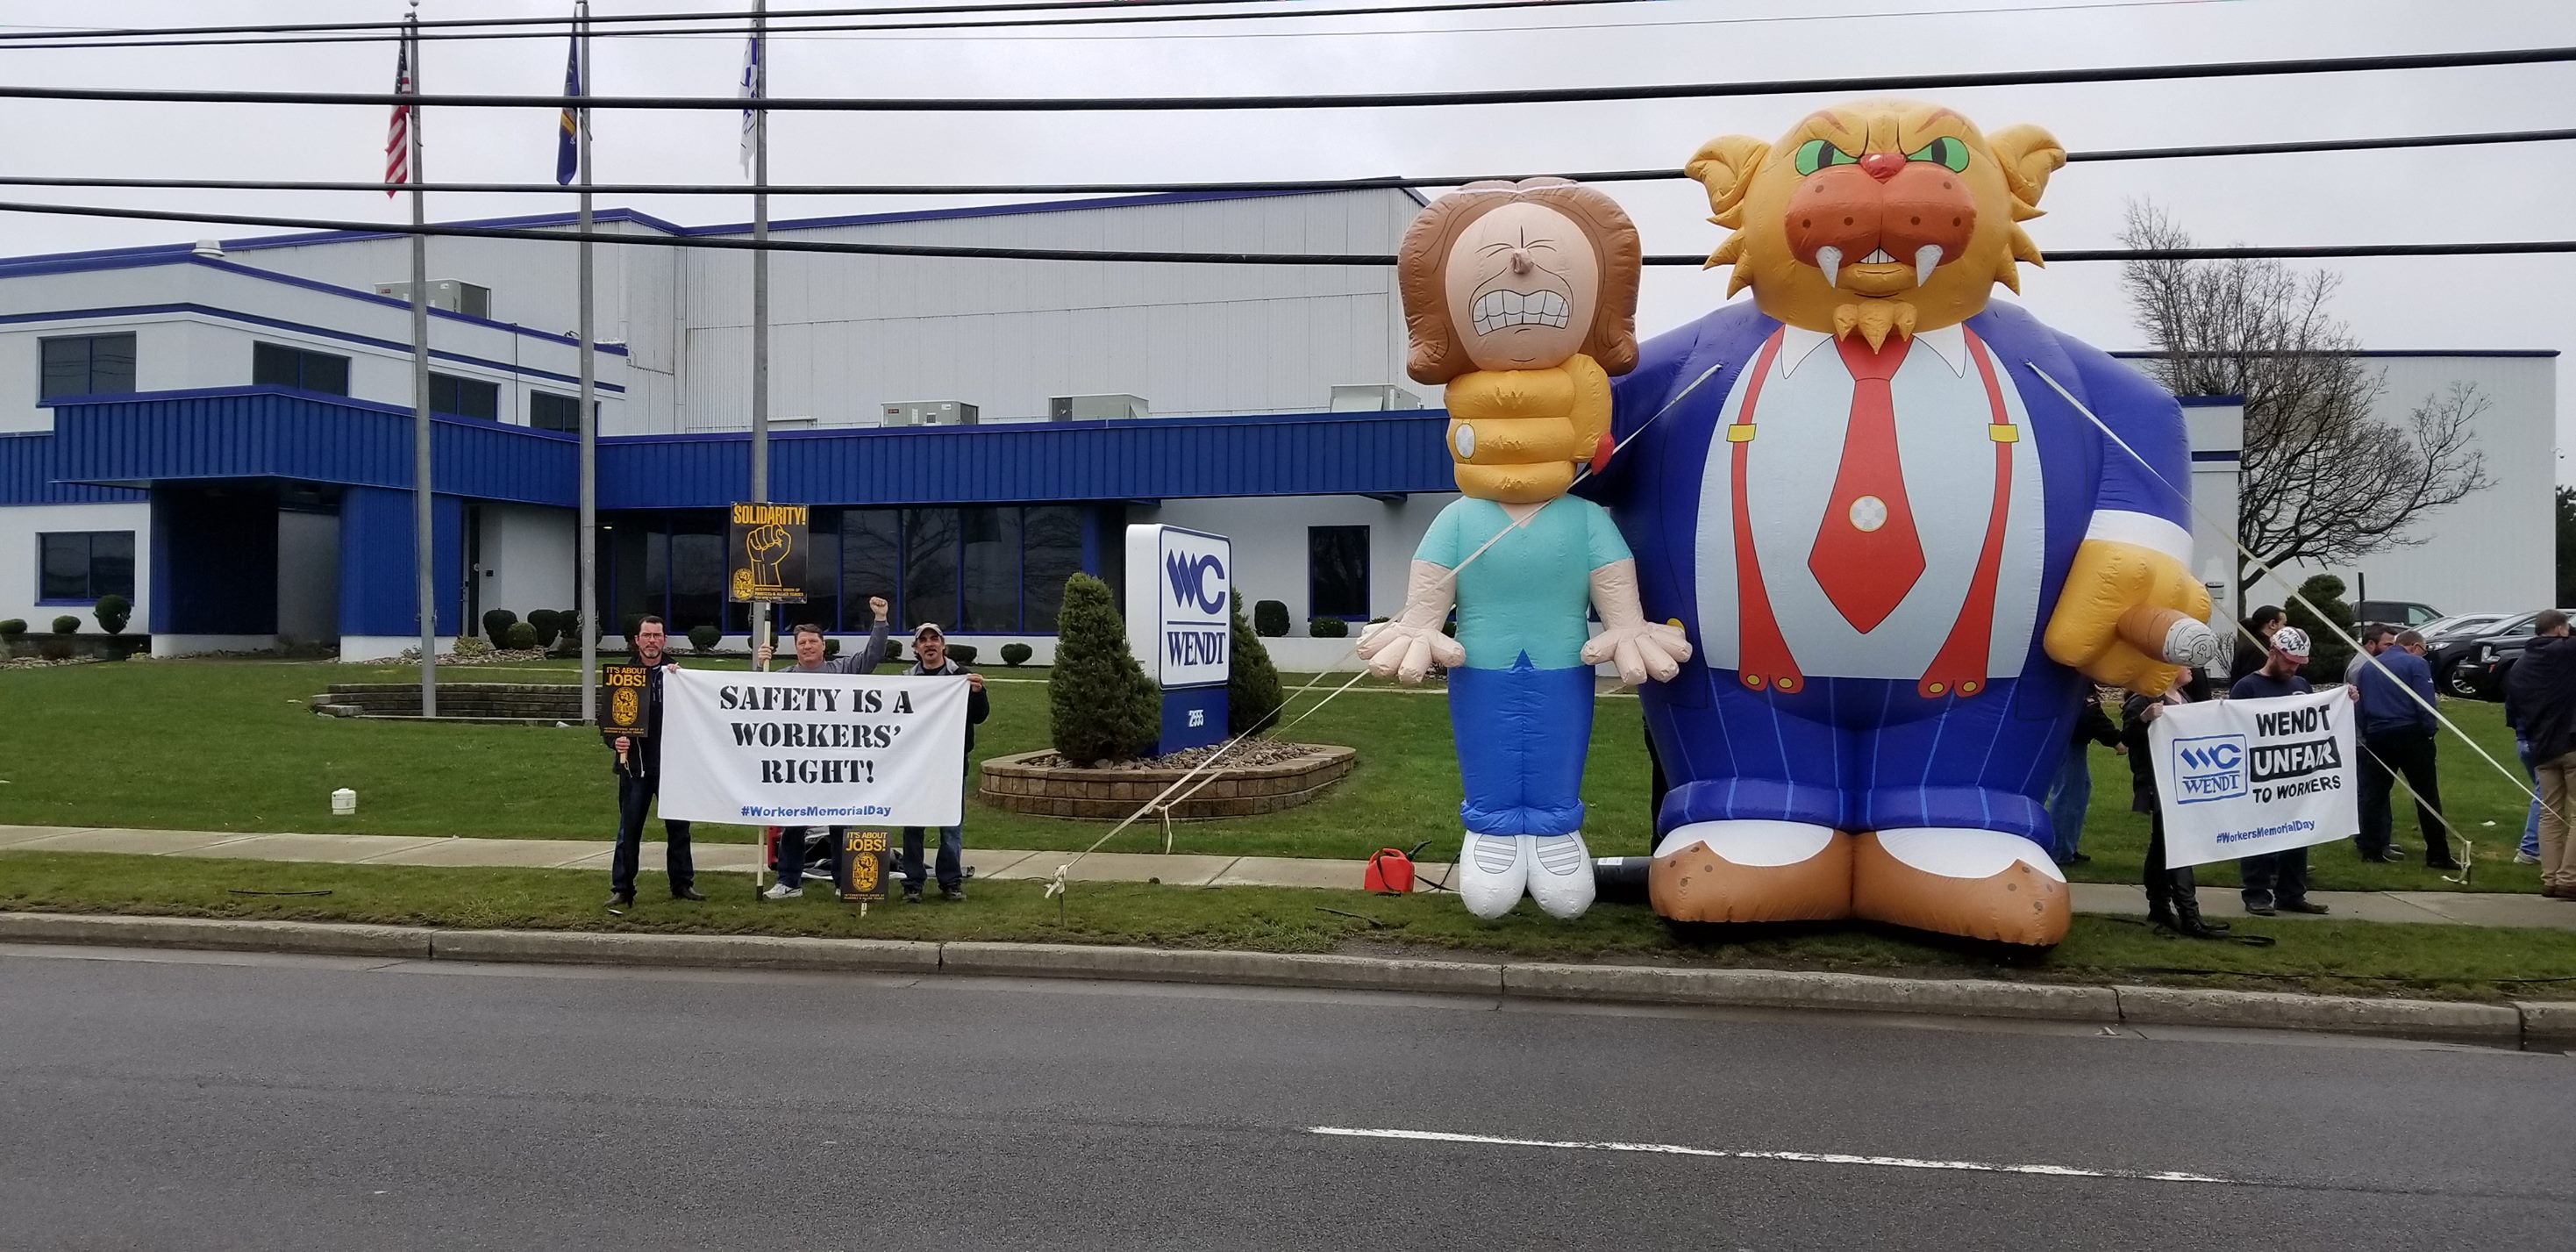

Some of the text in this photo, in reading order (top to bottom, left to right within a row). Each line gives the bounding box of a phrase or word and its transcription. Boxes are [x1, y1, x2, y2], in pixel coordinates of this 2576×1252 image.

[734, 505, 806, 525] SOLIDARITY!
[1167, 632, 1225, 667] WENDT
[606, 674, 646, 687] JOBS!
[720, 685, 914, 714] SAFETY IS A
[2256, 704, 2330, 737] WENDT
[731, 722, 902, 748] WORKERS'
[2255, 741, 2337, 776] UNFAIR
[761, 760, 874, 783] RIGHT!
[2182, 774, 2239, 794] WENDT
[2252, 775, 2341, 804] TO WORKERS
[741, 805, 892, 817] #WorkersMemorialDay
[2216, 820, 2316, 844] #WorkersMemorialDay
[846, 839, 886, 851] JOBS!
